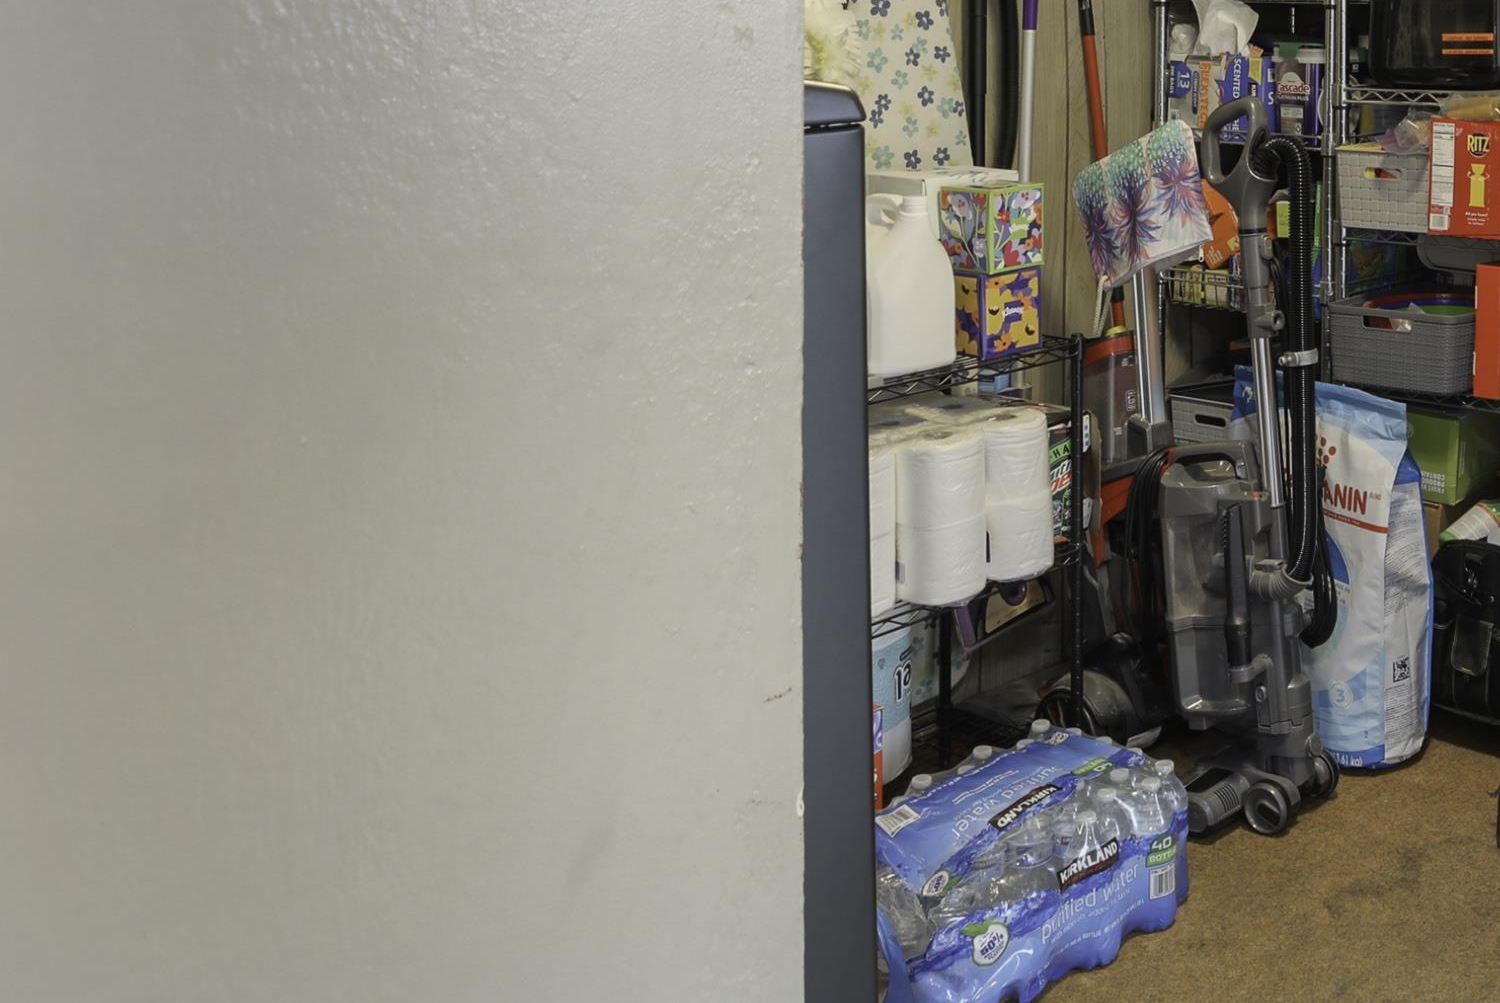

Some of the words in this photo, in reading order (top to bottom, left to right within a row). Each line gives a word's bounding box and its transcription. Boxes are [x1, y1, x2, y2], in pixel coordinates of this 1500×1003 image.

[1180, 73, 1190, 89] 13
[1232, 58, 1242, 98] SCENTED
[1467, 134, 1490, 153] RITZ
[1323, 480, 1367, 515] ANIN
[1336, 688, 1345, 703] 3
[951, 797, 1000, 838] water
[997, 785, 1058, 828] KIRKLAND
[1151, 836, 1172, 850] 40
[1059, 841, 1118, 883] KIRKLAND
[1041, 887, 1097, 944] purified
[1103, 864, 1139, 897] water
